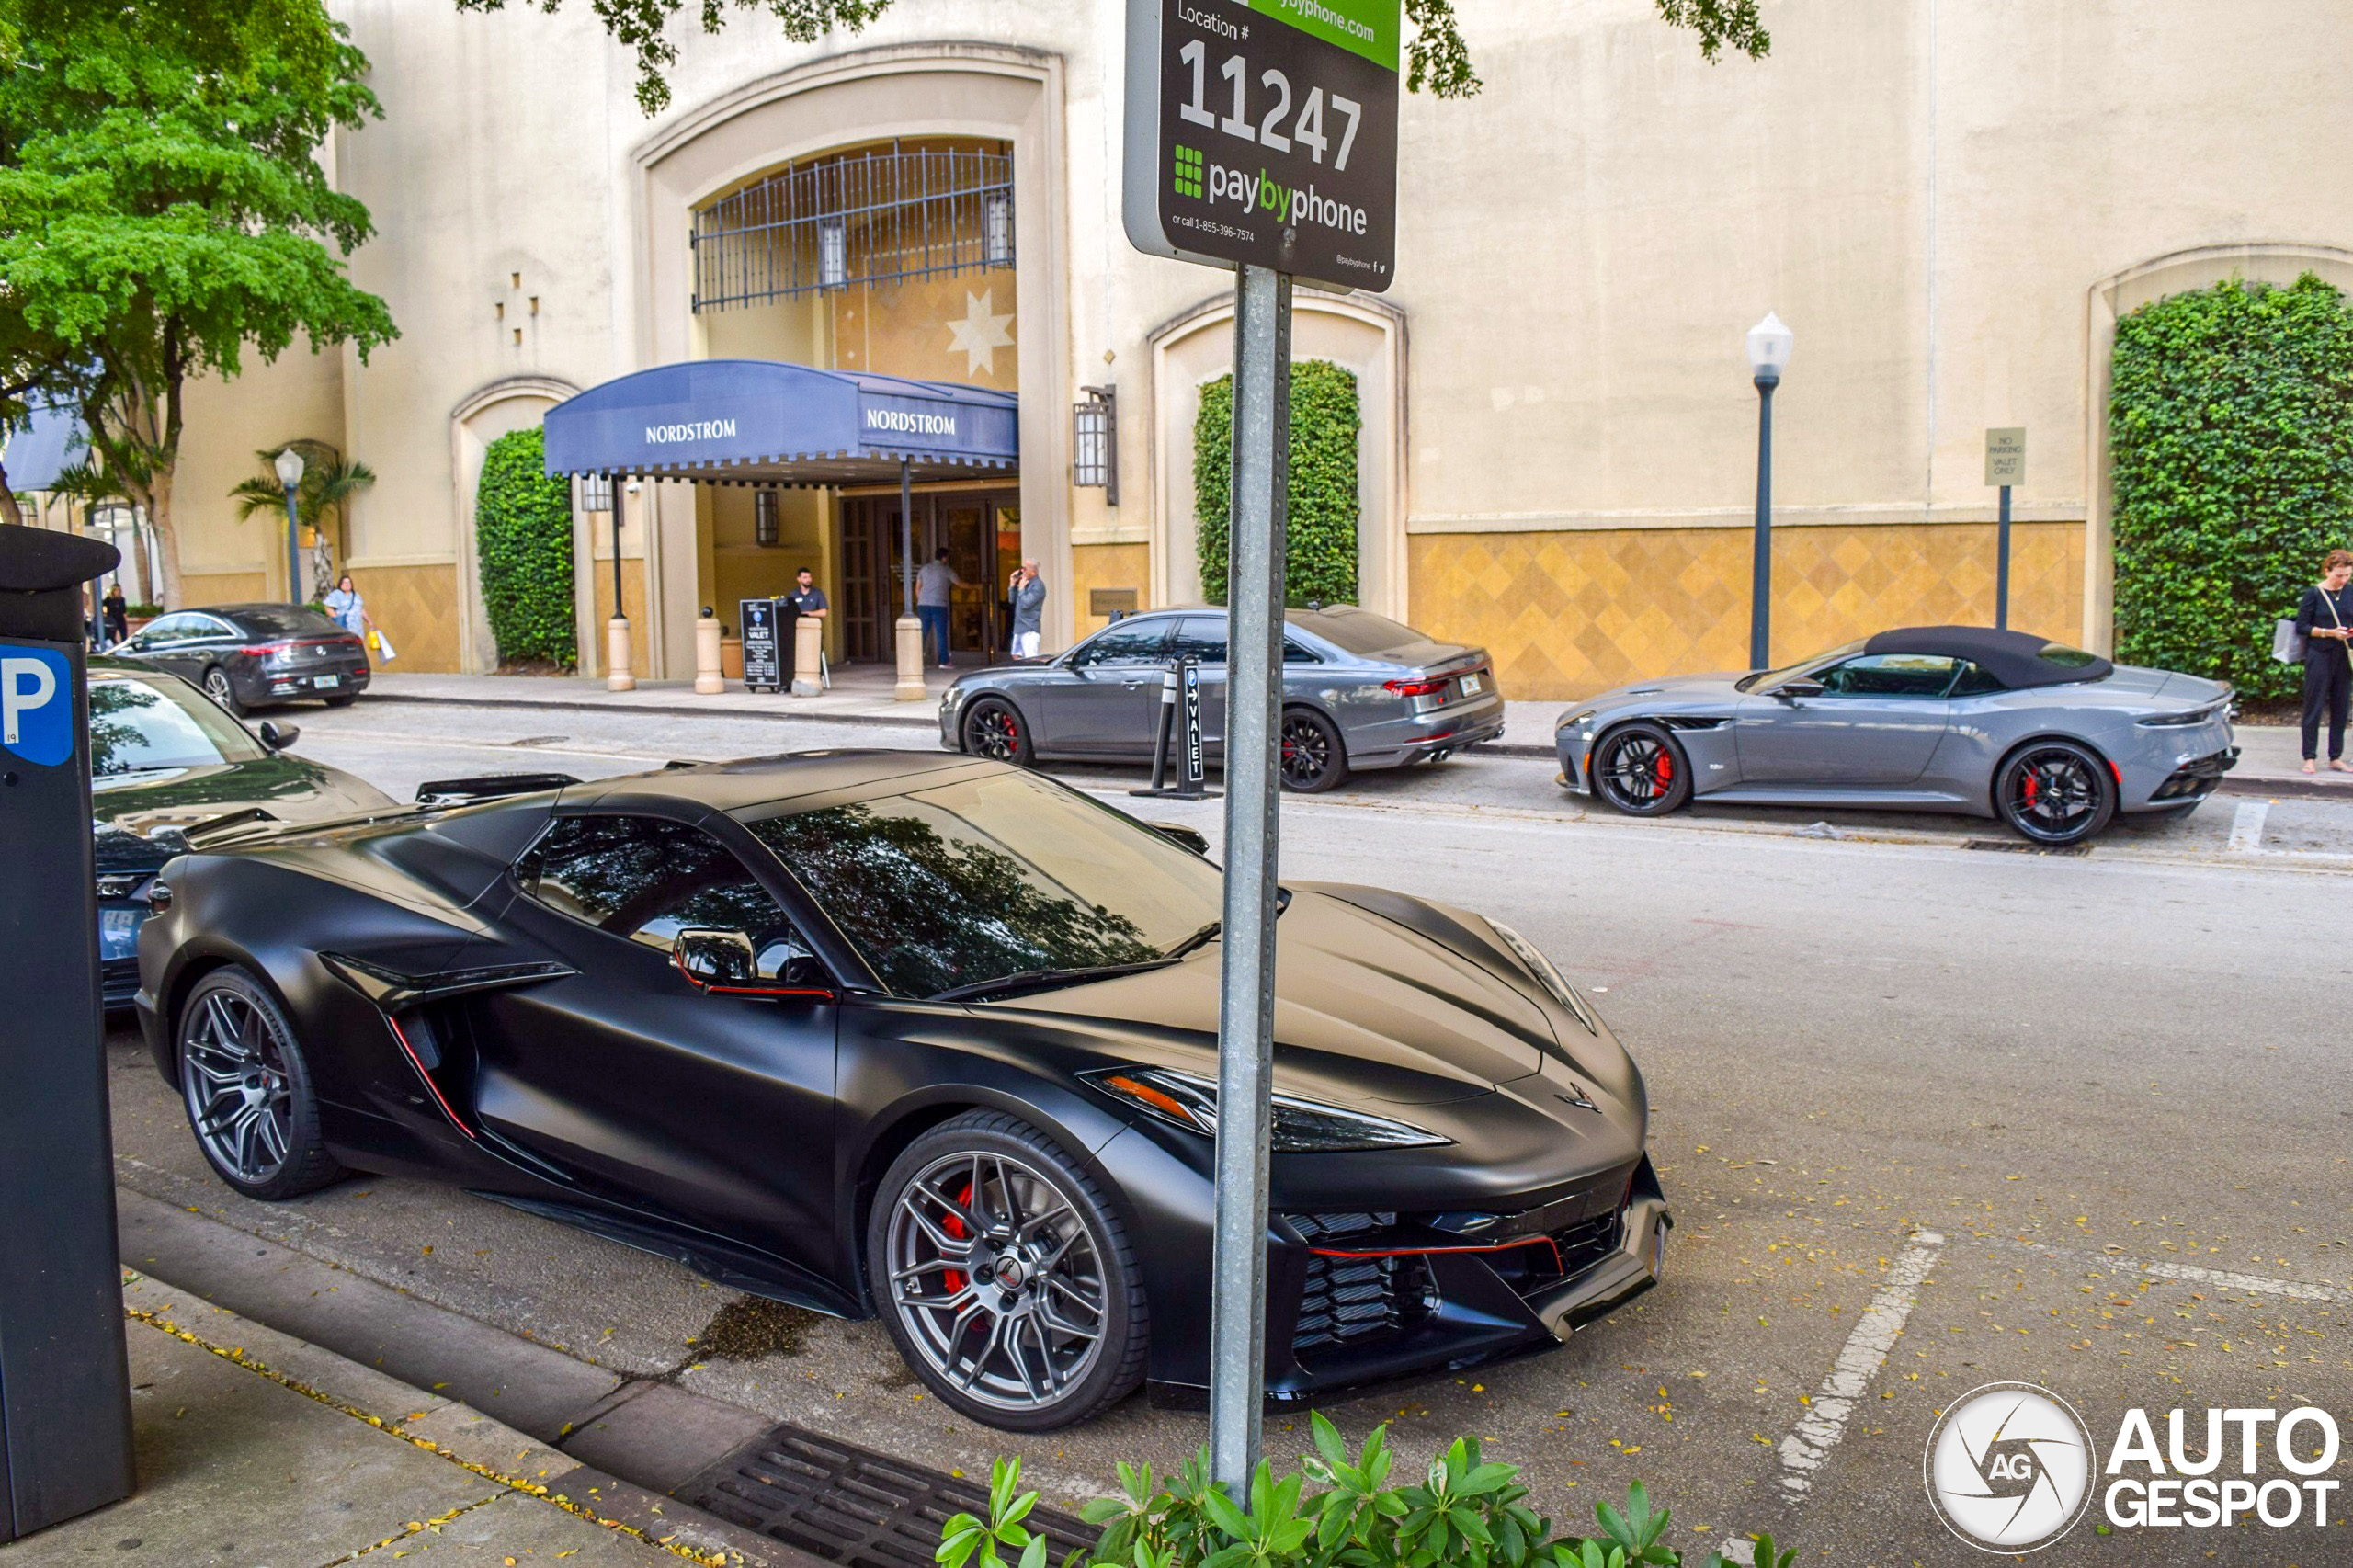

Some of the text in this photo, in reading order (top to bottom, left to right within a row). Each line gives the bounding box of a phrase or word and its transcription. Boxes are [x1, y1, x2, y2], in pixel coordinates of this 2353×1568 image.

[1178, 0, 1250, 40] Location #
[1179, 39, 1362, 172] 11247
[1209, 164, 1367, 235] paybyphone
[1172, 215, 1255, 242] or call 1-855-396-7574
[1336, 254, 1370, 270] @paybyphone
[645, 418, 736, 444] NORDSTROM
[867, 408, 956, 436] NORDSTROM
[1988, 445, 2023, 454] PARKING
[1998, 437, 2013, 446] NO
[1993, 466, 2016, 475] ONLY
[748, 631, 769, 640] VALET
[0, 657, 56, 744] P
[1189, 705, 1199, 773] VALET
